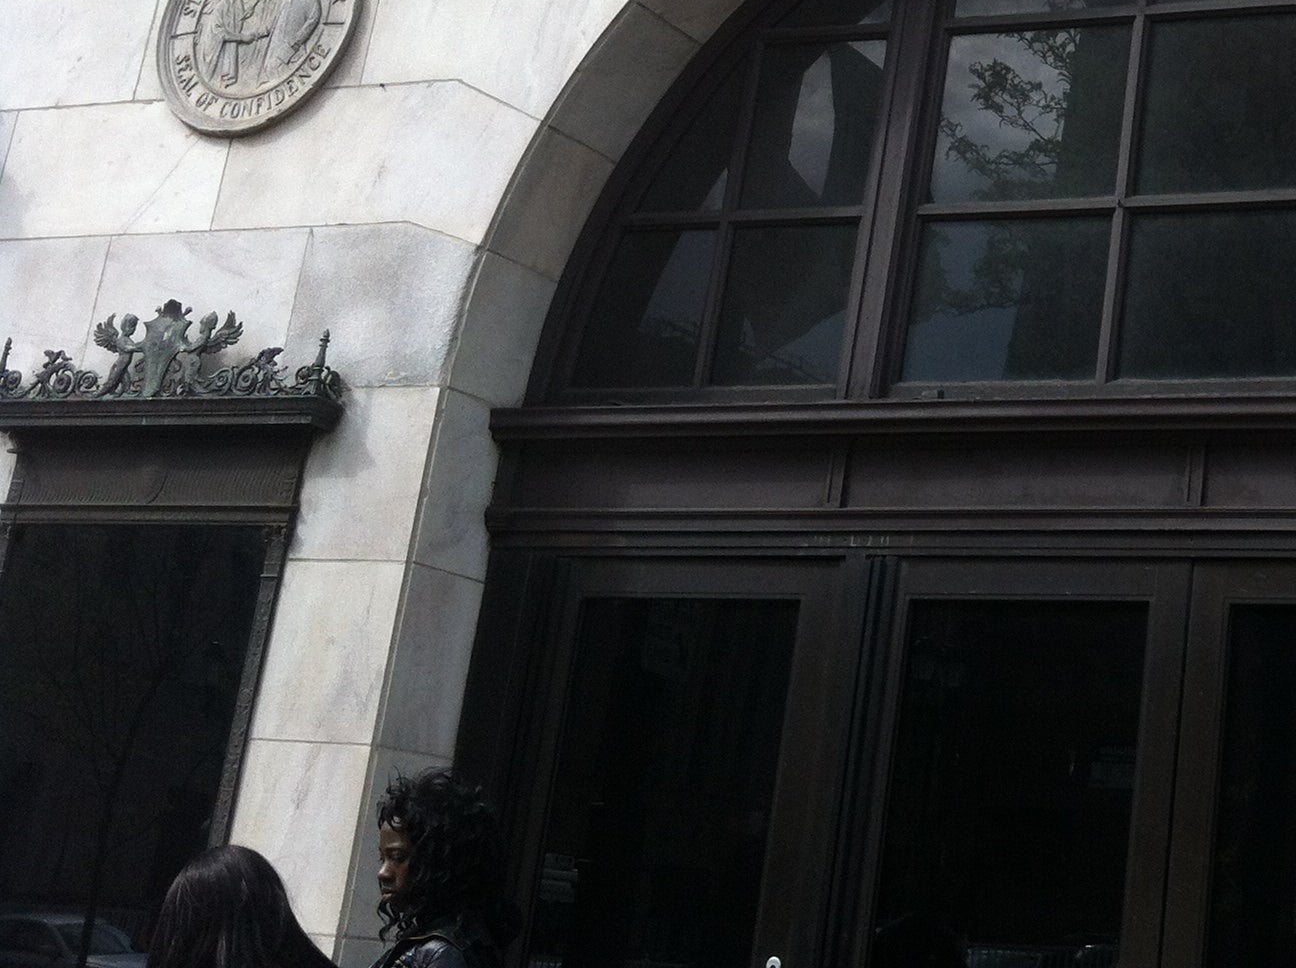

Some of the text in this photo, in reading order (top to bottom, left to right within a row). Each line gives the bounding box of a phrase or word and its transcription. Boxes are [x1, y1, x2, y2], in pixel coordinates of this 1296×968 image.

[175, 41, 332, 120] SEAL OF CONFIDENCE
